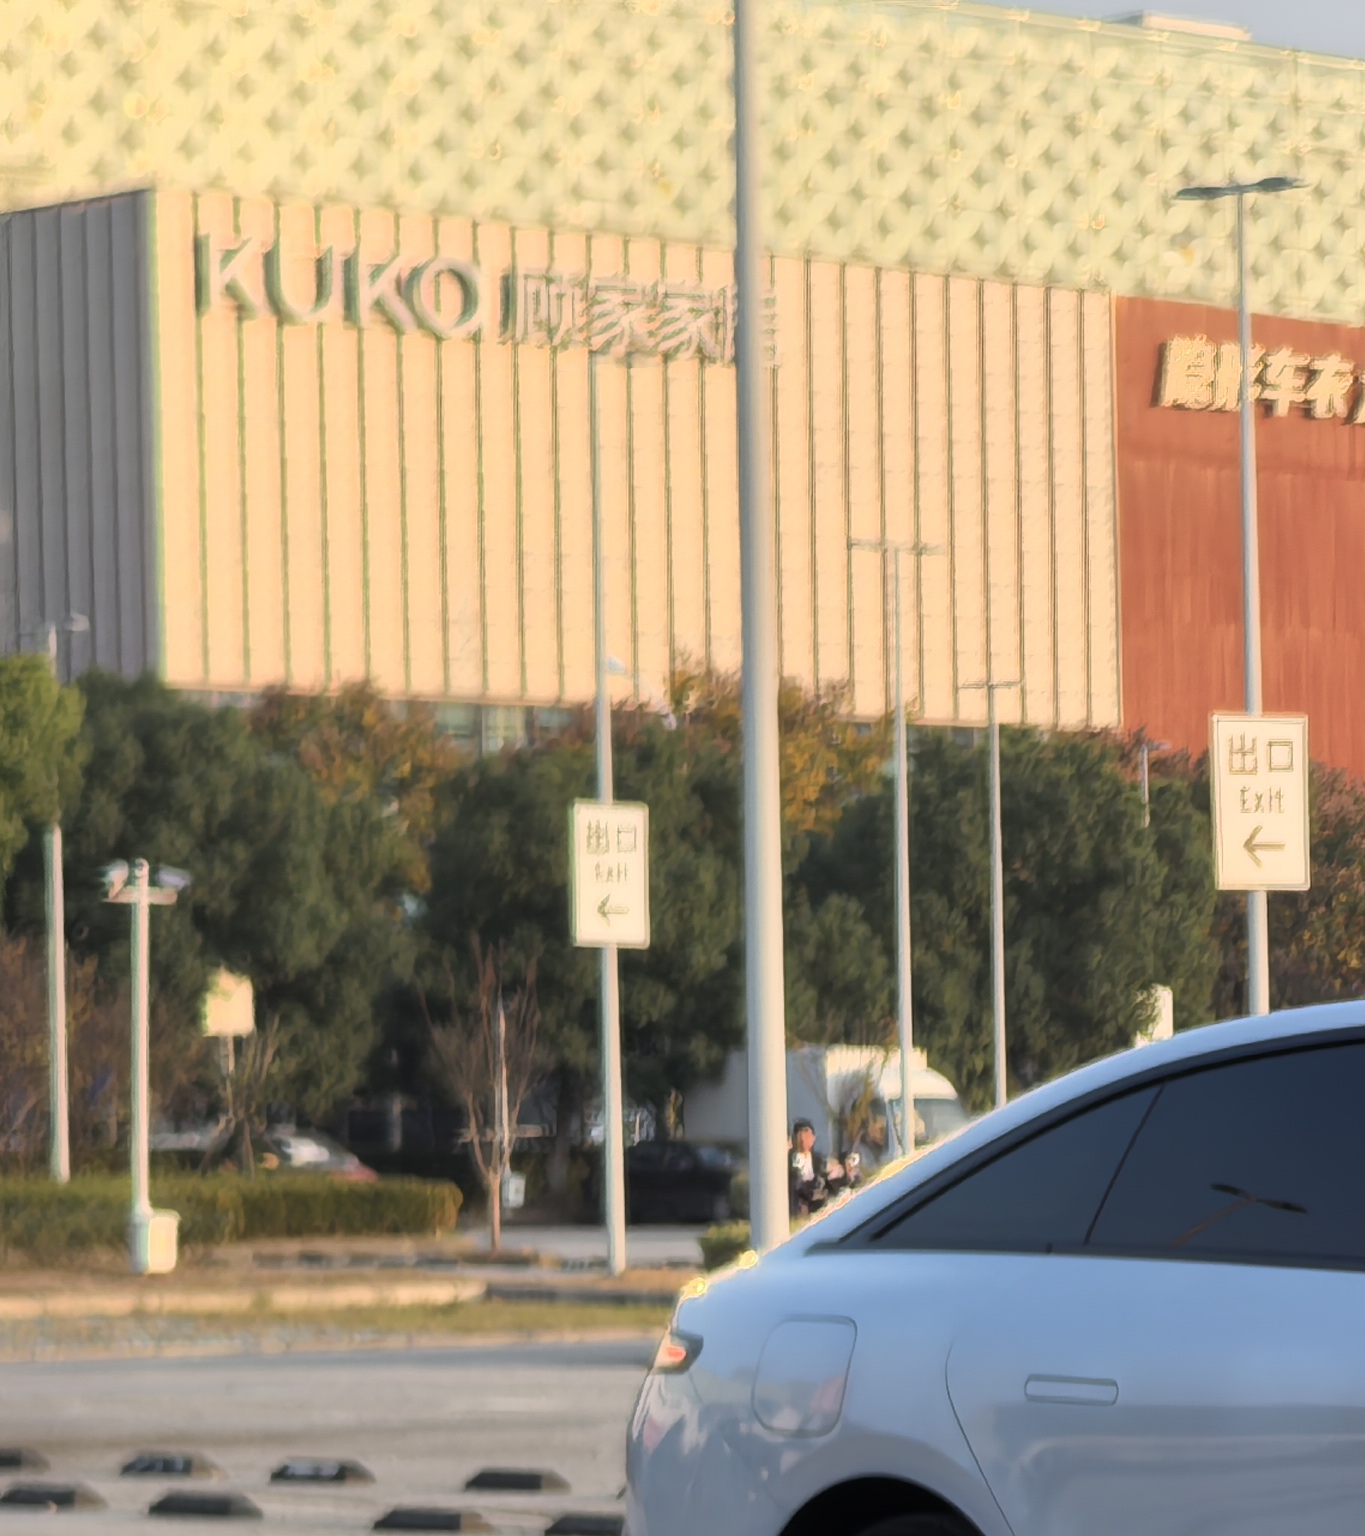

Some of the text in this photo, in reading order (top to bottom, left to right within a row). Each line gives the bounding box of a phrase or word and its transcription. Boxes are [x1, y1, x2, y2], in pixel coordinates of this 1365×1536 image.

[194, 232, 482, 340] KUKO
[1228, 732, 1295, 776] 出口
[1239, 786, 1285, 814] Exit
[586, 818, 637, 856] 出口
